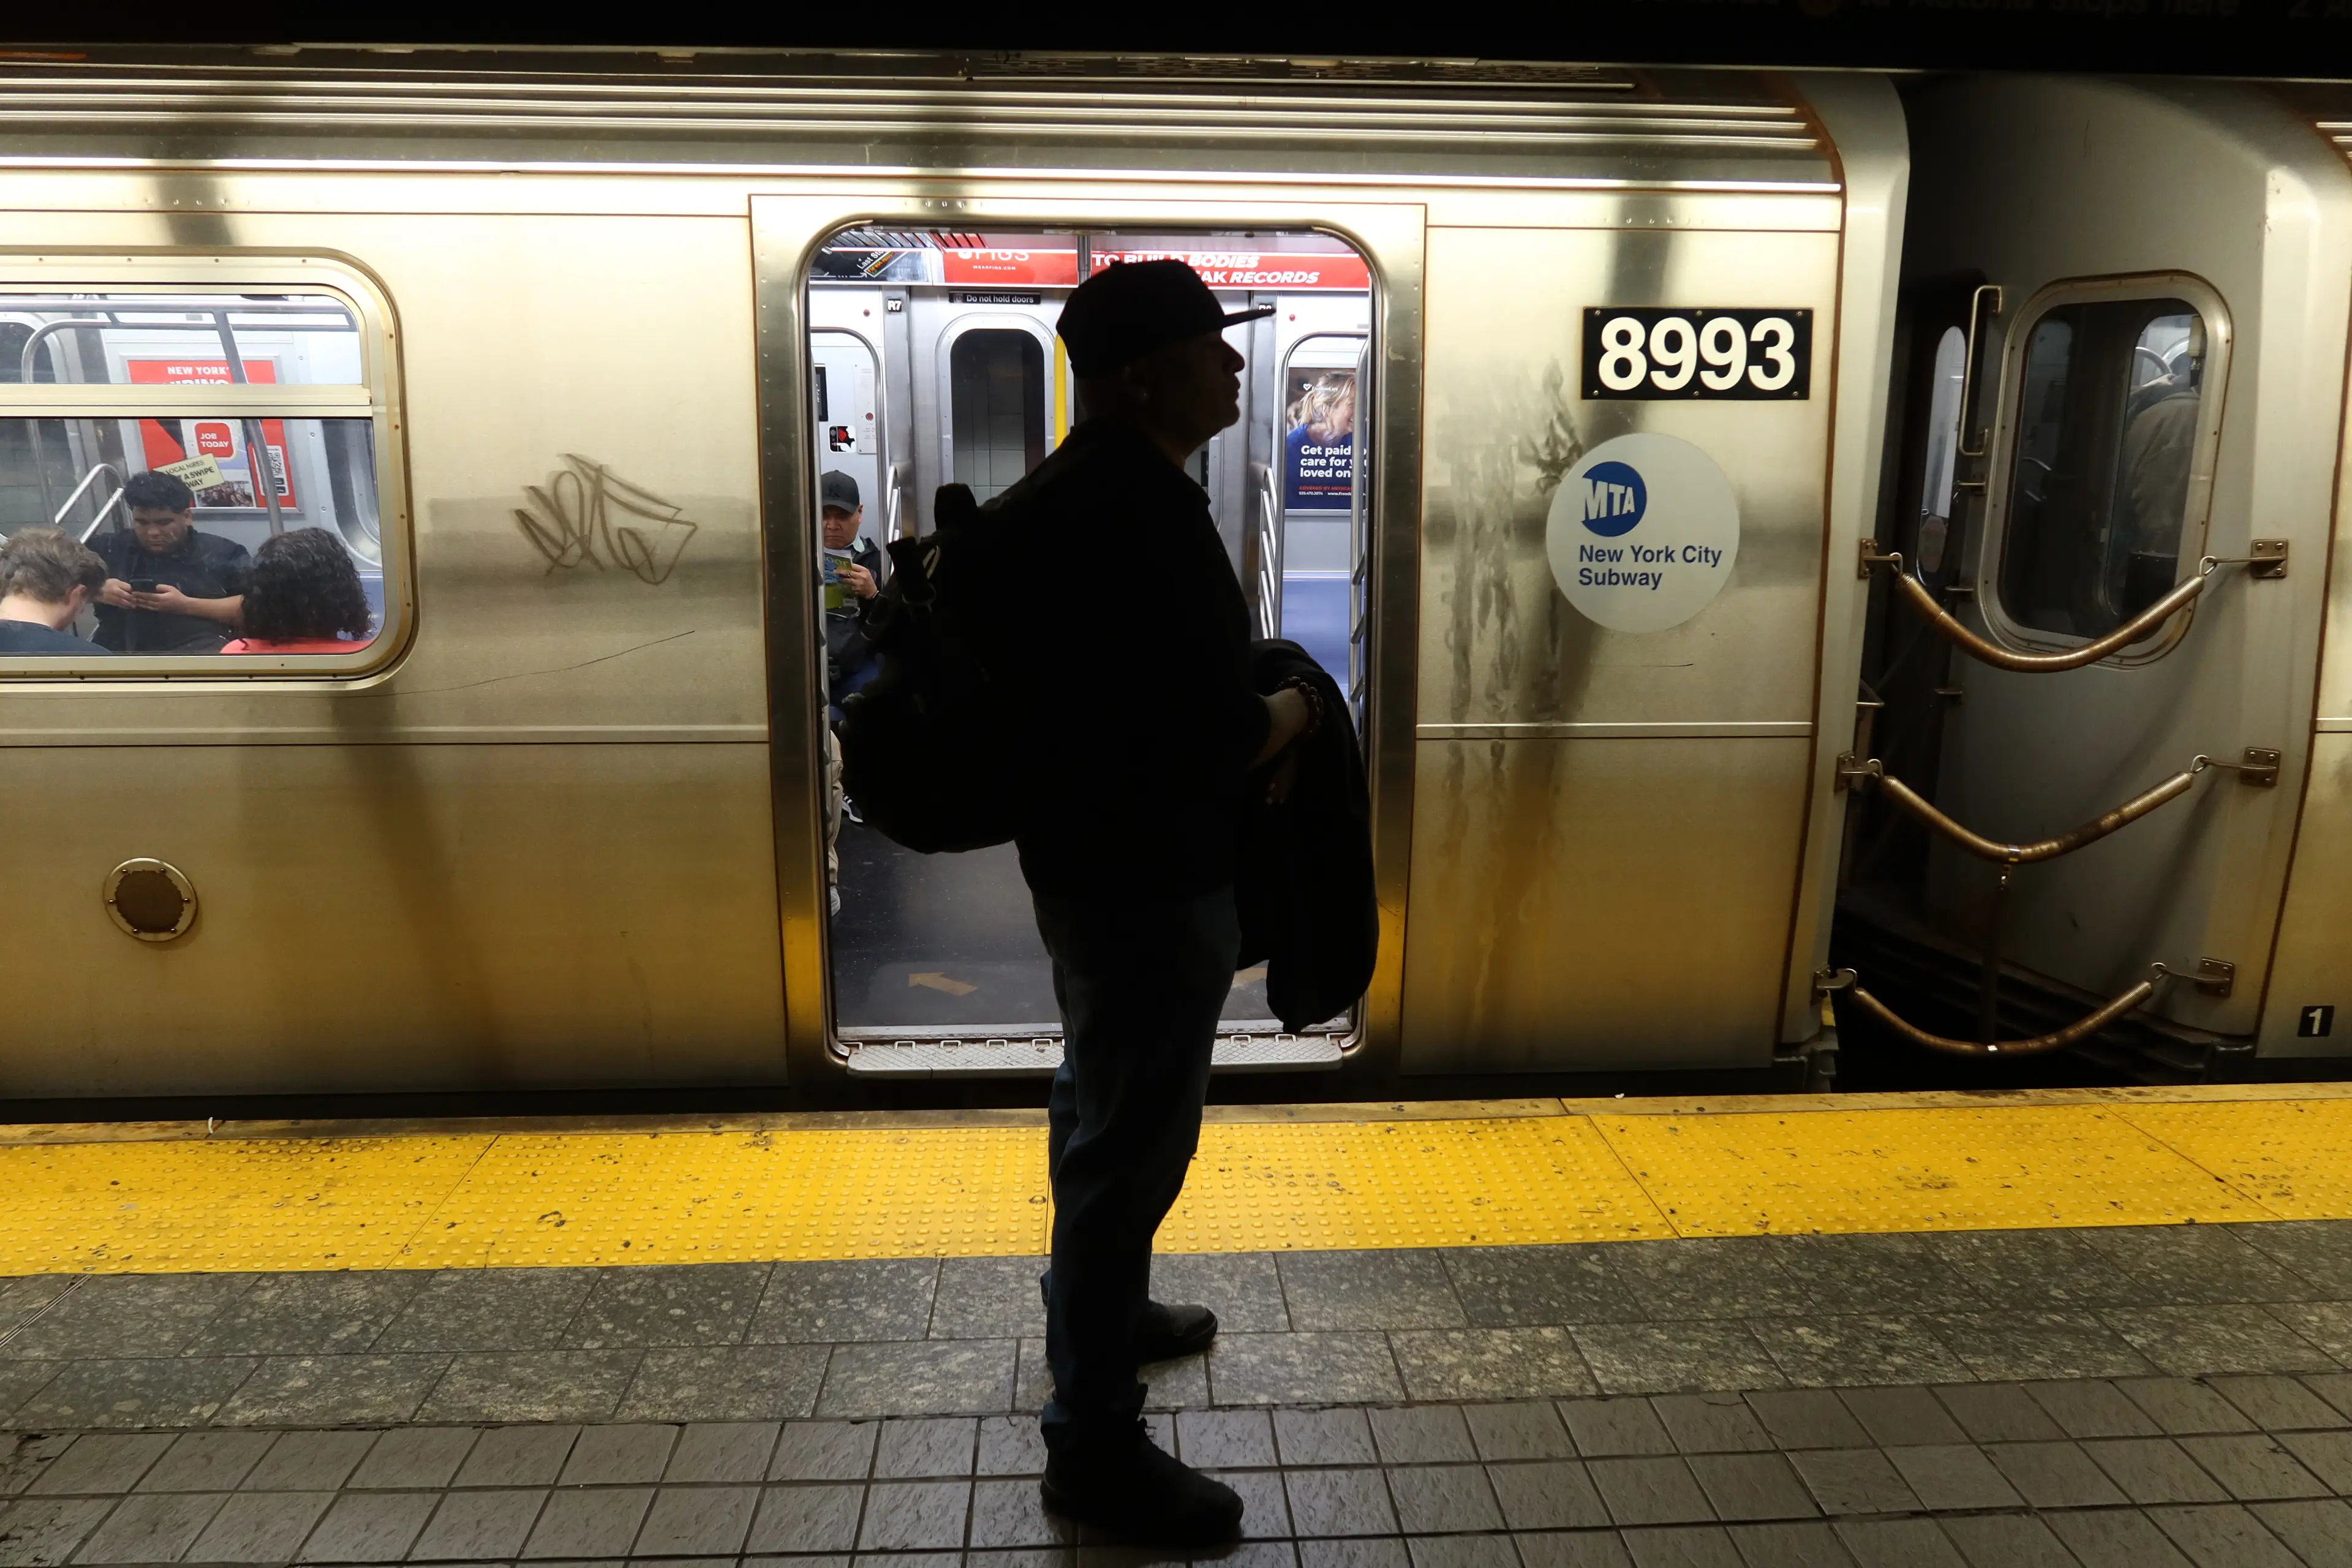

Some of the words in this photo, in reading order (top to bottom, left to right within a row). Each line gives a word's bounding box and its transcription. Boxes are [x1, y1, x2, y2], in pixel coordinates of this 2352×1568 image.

[857, 257, 873, 270] Last
[870, 250, 884, 258] Sto
[1092, 254, 1120, 266] TO
[1188, 255, 1259, 268] BODIES
[1229, 271, 1320, 284] RECORDS
[888, 300, 902, 311] R7
[1598, 317, 1795, 391] 8993
[167, 366, 192, 375] NEW
[1301, 445, 1322, 455] Get
[1325, 445, 1351, 457] paid
[1329, 456, 1347, 466] for
[165, 466, 186, 475] LOCAL
[190, 466, 215, 478] SWIPE
[1300, 467, 1333, 478] loved
[185, 478, 203, 488] WAY
[1582, 478, 1635, 521] MTA
[1579, 545, 1624, 563] New
[1630, 545, 1676, 564] York
[1682, 545, 1722, 568] City
[1578, 567, 1663, 591] Subway
[2308, 1008, 2323, 1035] 1
